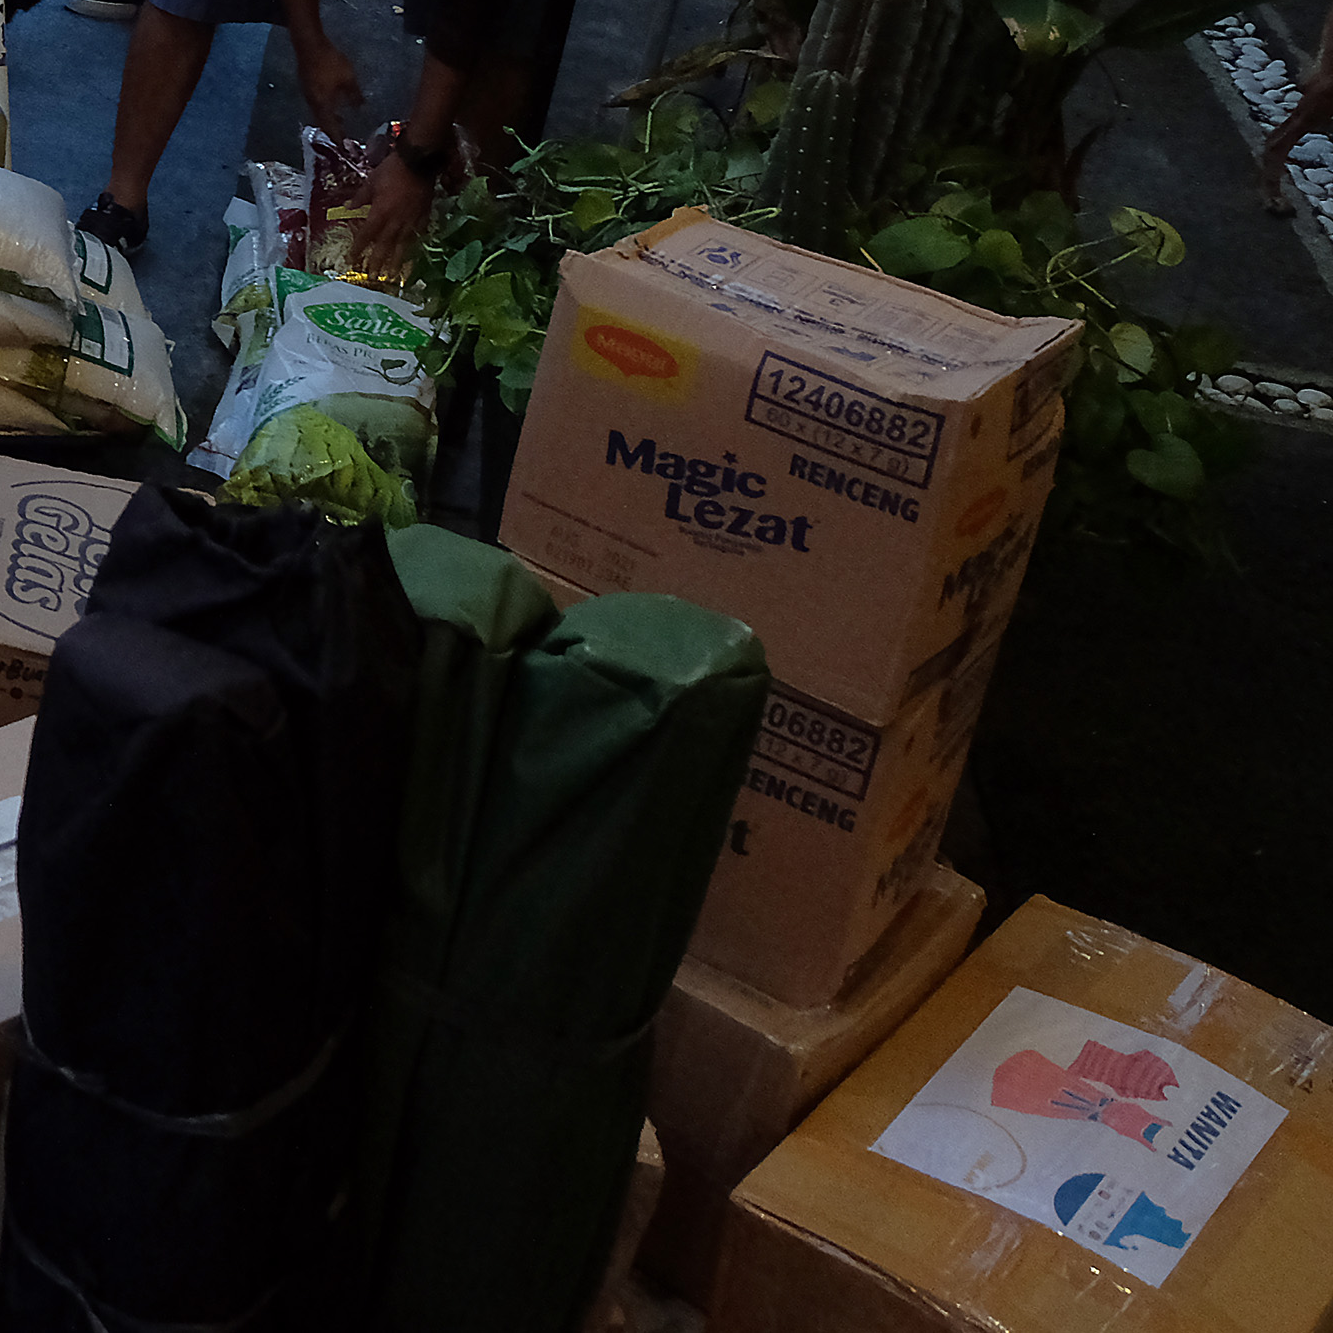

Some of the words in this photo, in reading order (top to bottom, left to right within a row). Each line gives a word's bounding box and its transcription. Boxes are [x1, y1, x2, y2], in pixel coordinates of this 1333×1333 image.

[327, 309, 409, 339] Sania
[769, 369, 931, 449] 12406882
[605, 429, 766, 500] Magic
[789, 453, 920, 524] RENCENG
[4, 493, 95, 614] Gelas
[664, 482, 815, 554] Lezat
[767, 702, 871, 765] 06882
[1166, 1089, 1243, 1172] WANITA
